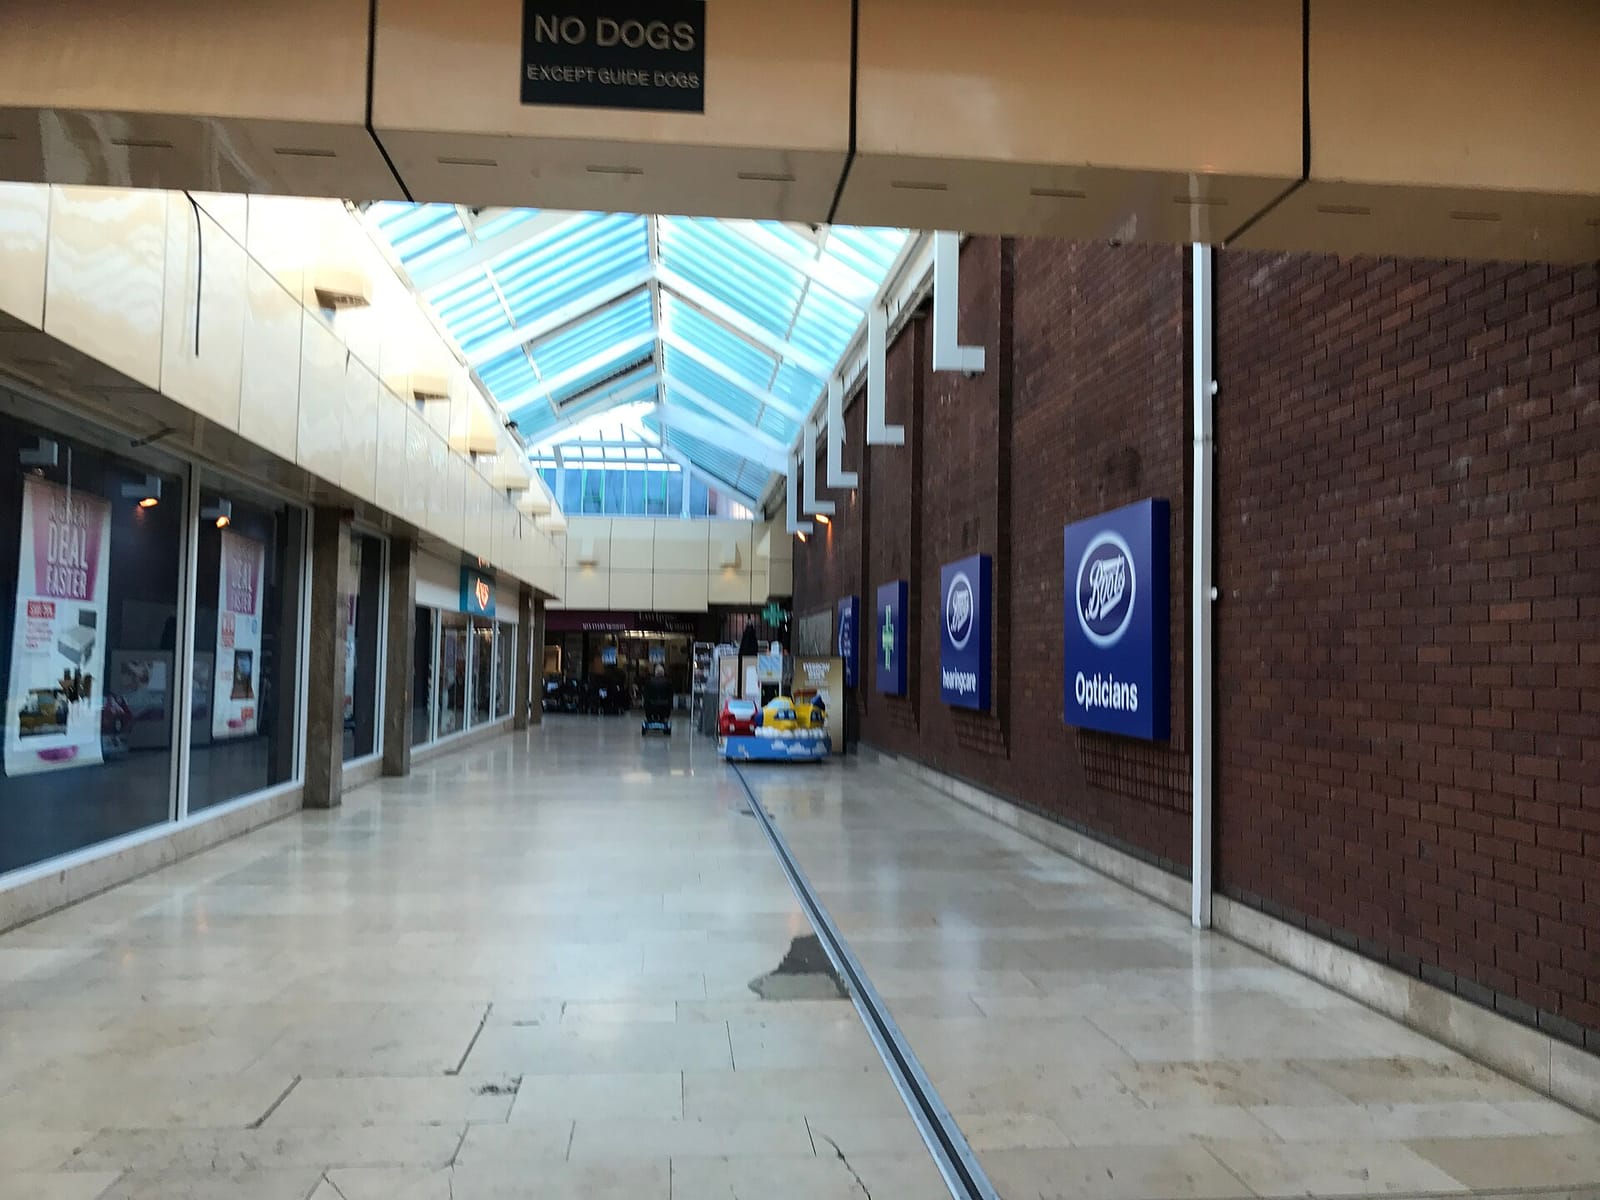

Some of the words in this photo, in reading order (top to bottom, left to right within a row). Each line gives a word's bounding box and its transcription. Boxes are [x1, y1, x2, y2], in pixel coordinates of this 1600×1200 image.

[534, 14, 587, 45] NO
[596, 17, 696, 51] DOGS
[527, 64, 596, 83] EXCEPT
[598, 67, 650, 87] GUIDE
[653, 70, 699, 88] DOGS
[47, 521, 89, 570] DEAL
[46, 563, 88, 599] FASTER
[1085, 554, 1126, 621] Boots
[1075, 670, 1138, 712] Opticians
